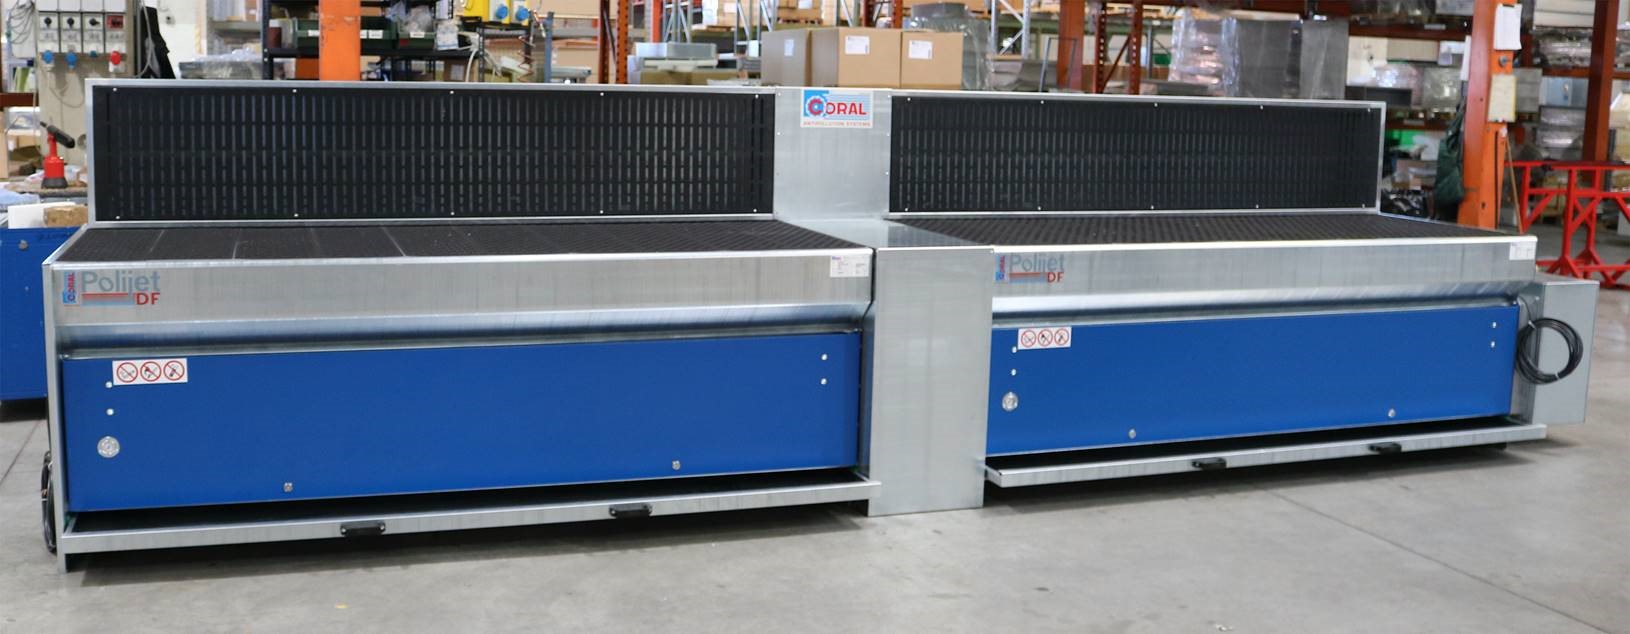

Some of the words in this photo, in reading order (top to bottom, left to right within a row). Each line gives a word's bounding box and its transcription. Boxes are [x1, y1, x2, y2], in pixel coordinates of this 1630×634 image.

[808, 98, 867, 116] CORAL
[1010, 253, 1065, 275] Polijet
[81, 270, 160, 295] Polijet
[1047, 271, 1065, 283] DF
[135, 292, 161, 306] DF
